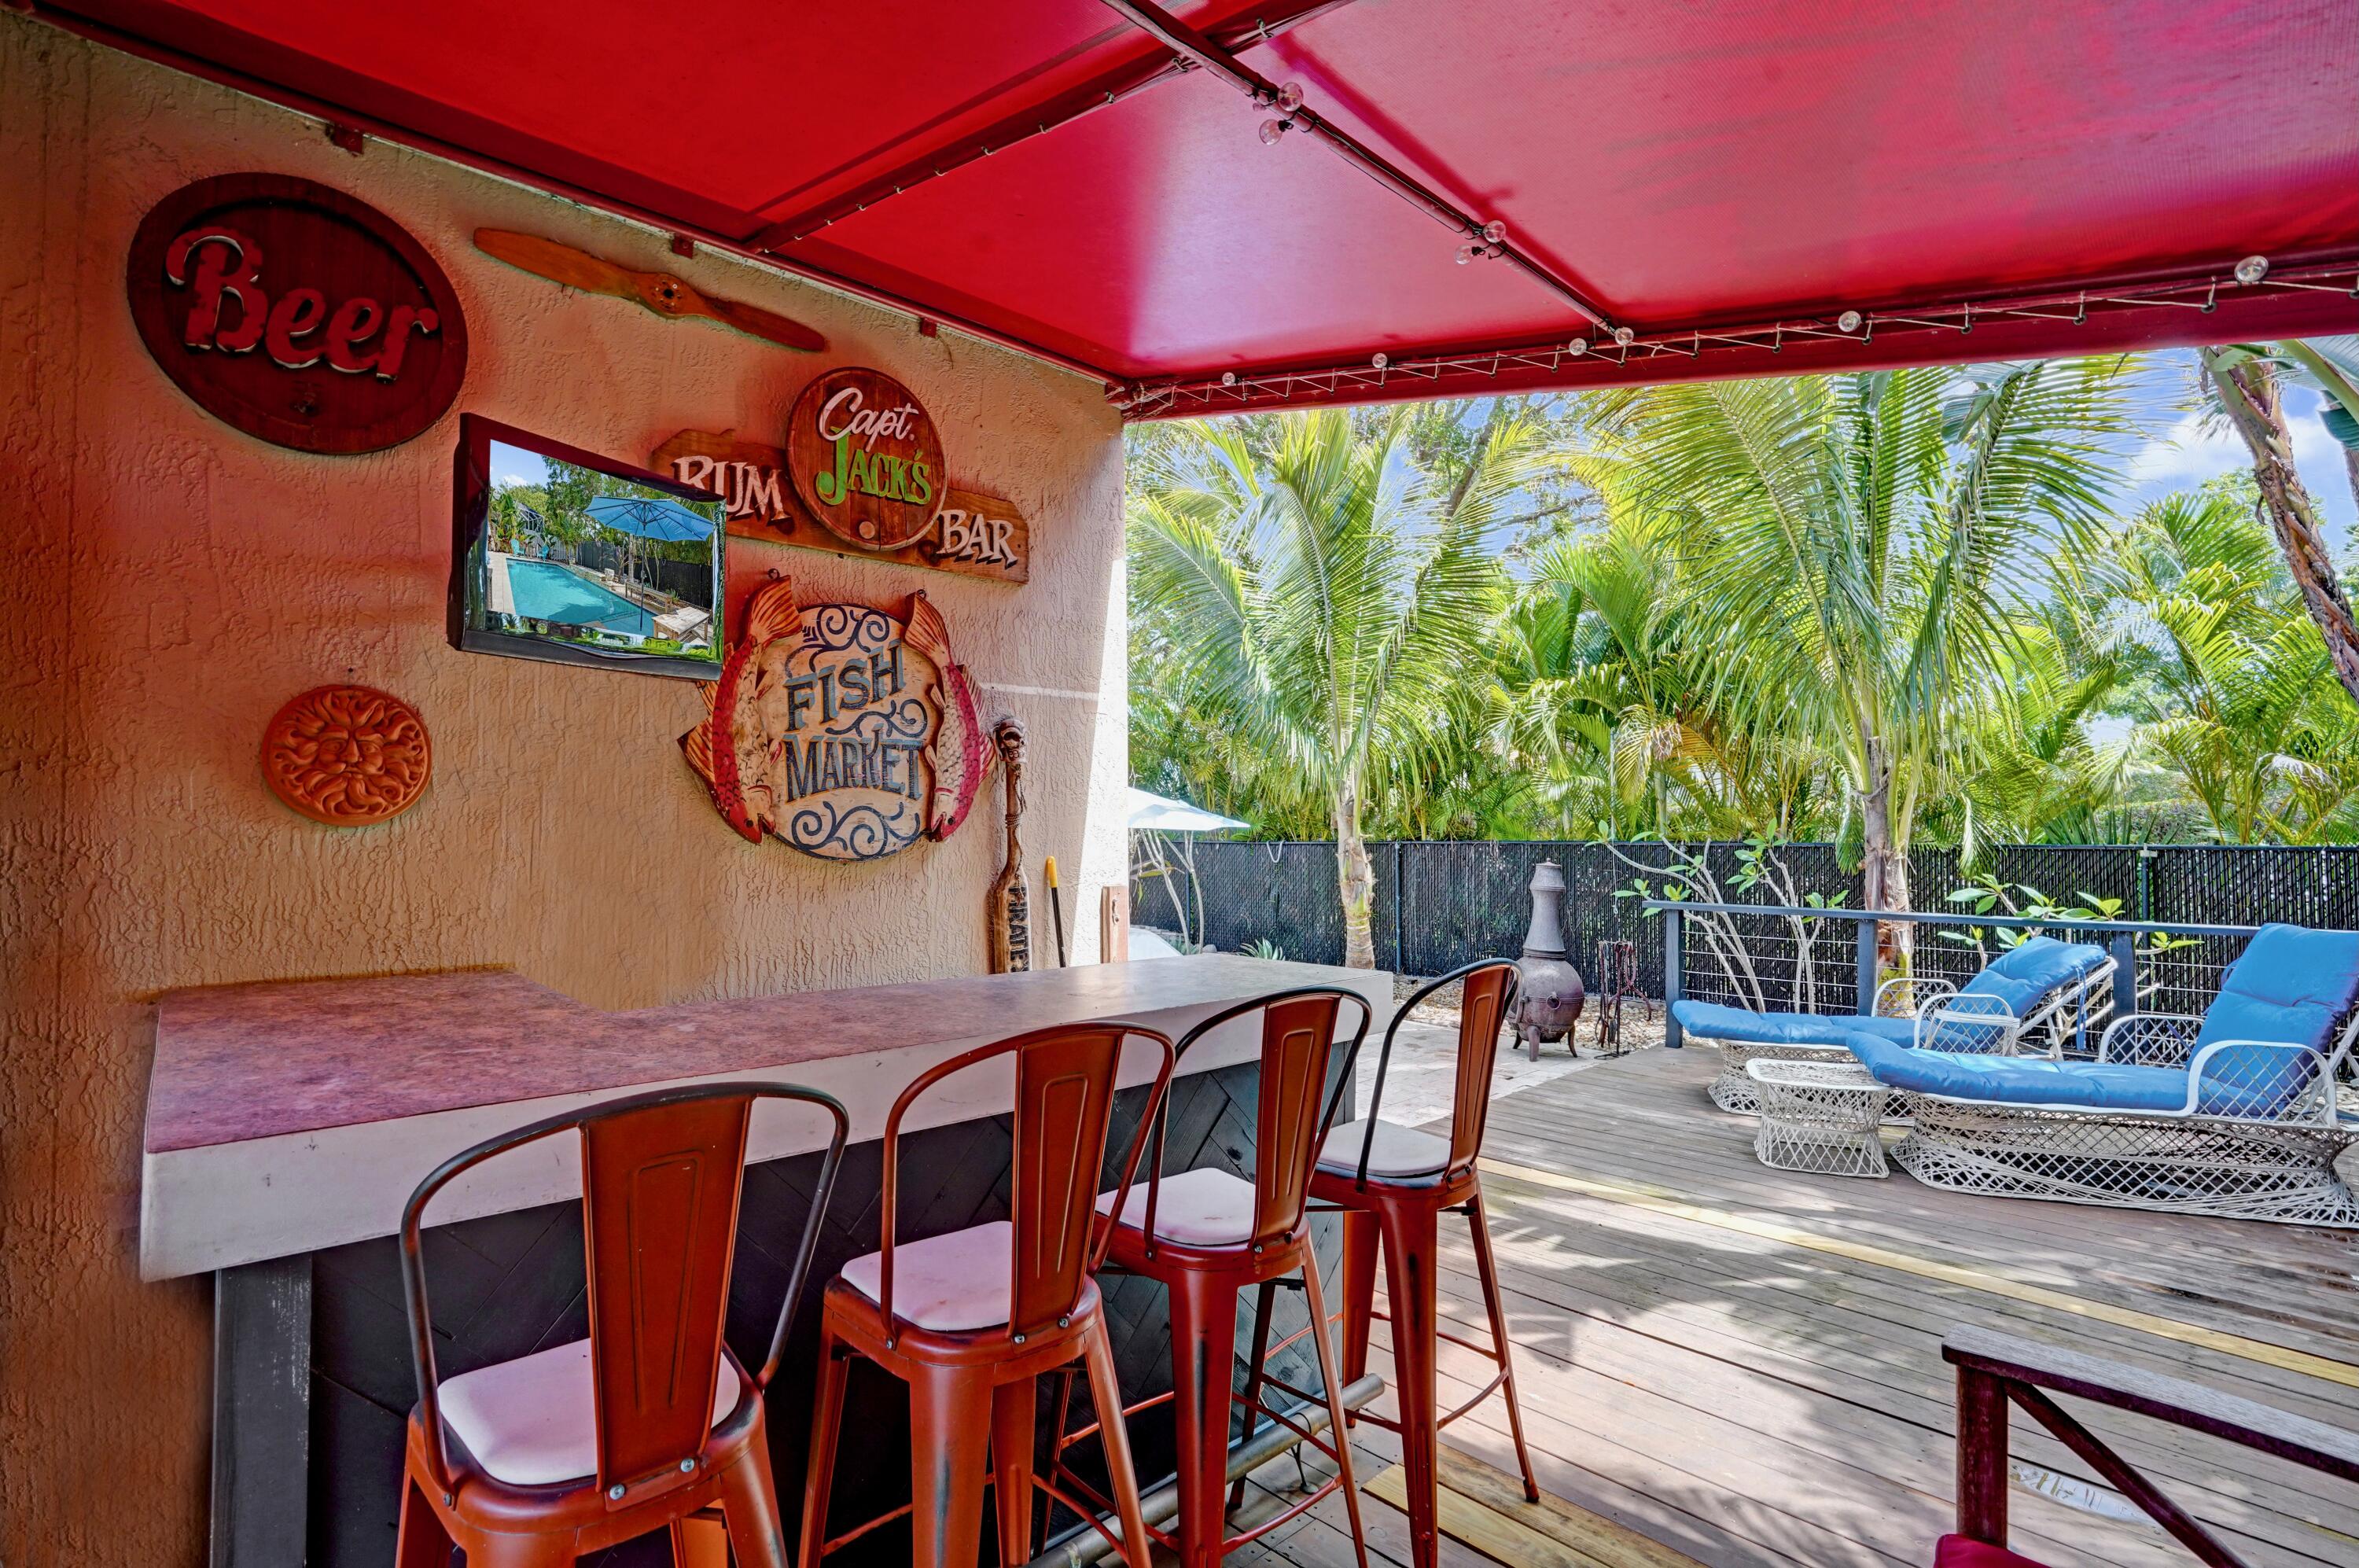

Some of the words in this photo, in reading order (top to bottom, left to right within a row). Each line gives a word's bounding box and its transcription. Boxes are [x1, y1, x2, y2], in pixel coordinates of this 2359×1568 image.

[165, 226, 439, 382] Beer
[819, 387, 919, 452] Capt.
[815, 425, 932, 506] JACK'S
[672, 455, 792, 521] RUM
[936, 509, 1019, 566] BAR
[783, 639, 907, 733] FISH
[785, 723, 925, 804] MARKET
